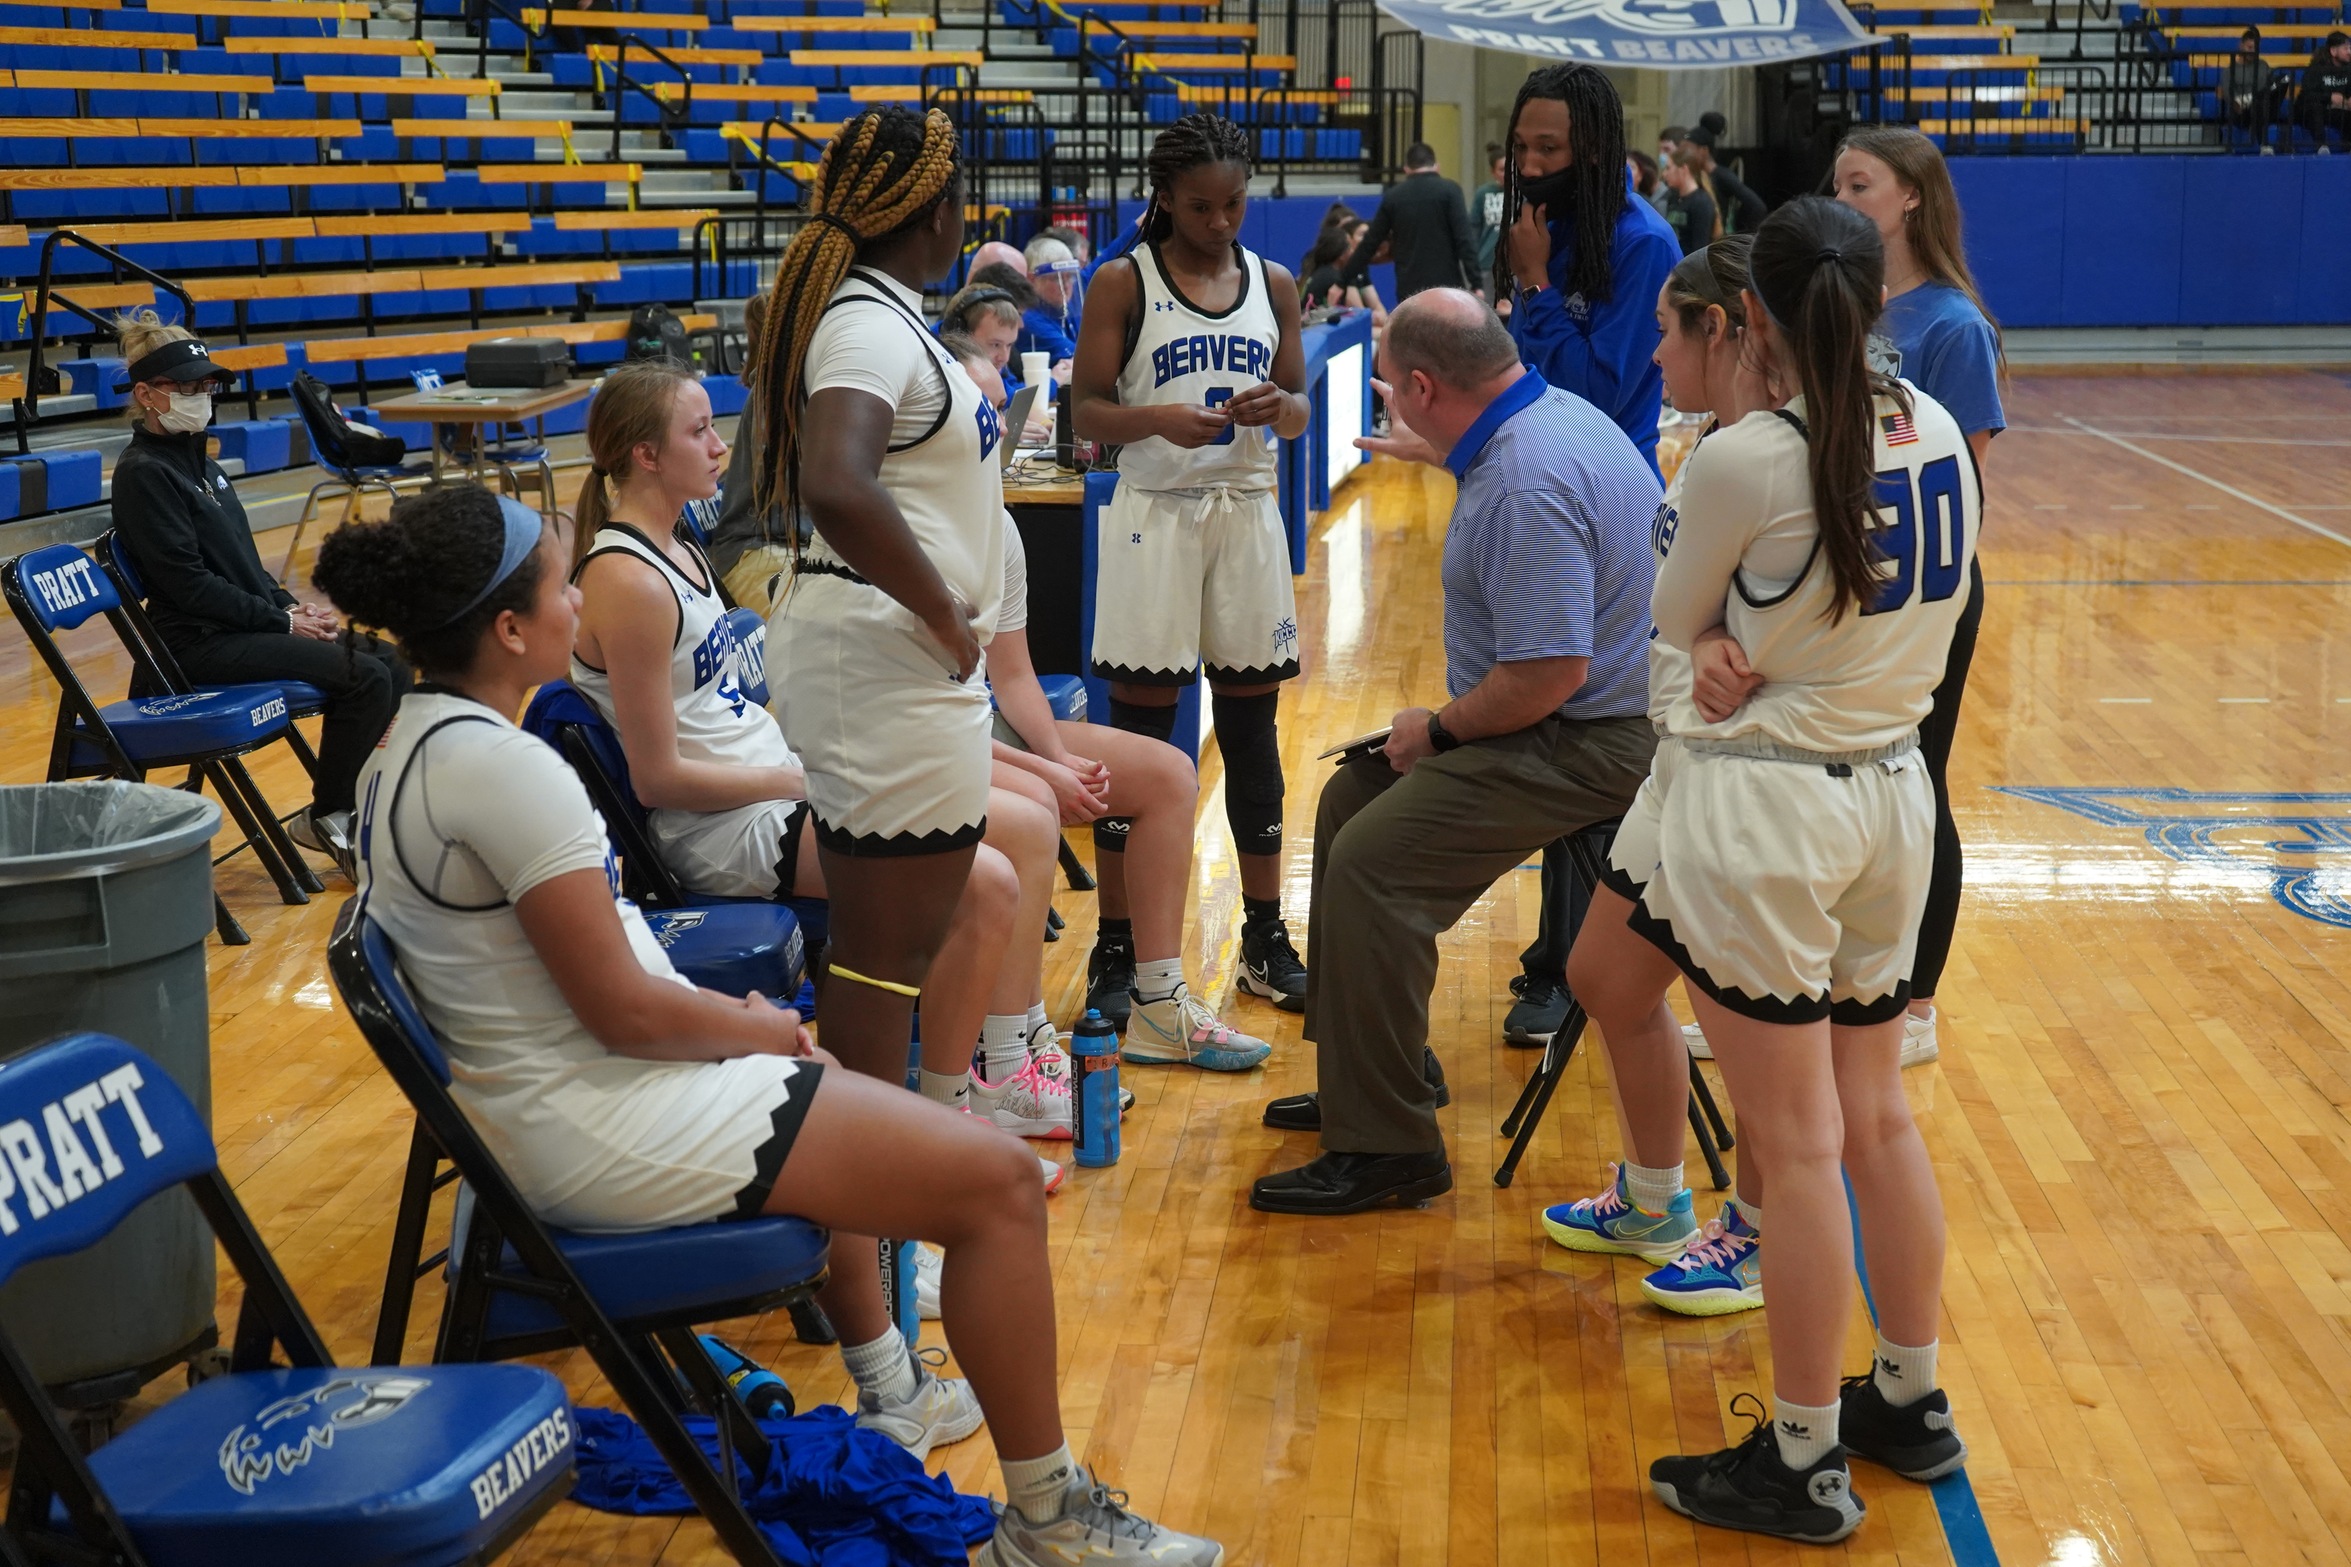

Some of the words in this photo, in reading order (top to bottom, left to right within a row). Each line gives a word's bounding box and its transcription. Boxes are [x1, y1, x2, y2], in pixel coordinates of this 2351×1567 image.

[1447, 24, 1604, 58] PRATT
[1611, 34, 1819, 60] BEAVERS
[1152, 334, 1270, 389] BEAVERS
[32, 556, 100, 613] PRATT
[250, 696, 287, 728] BEAVERS
[1072, 1059, 1080, 1141] POWERADE
[469, 1406, 571, 1521] BEAVERS
